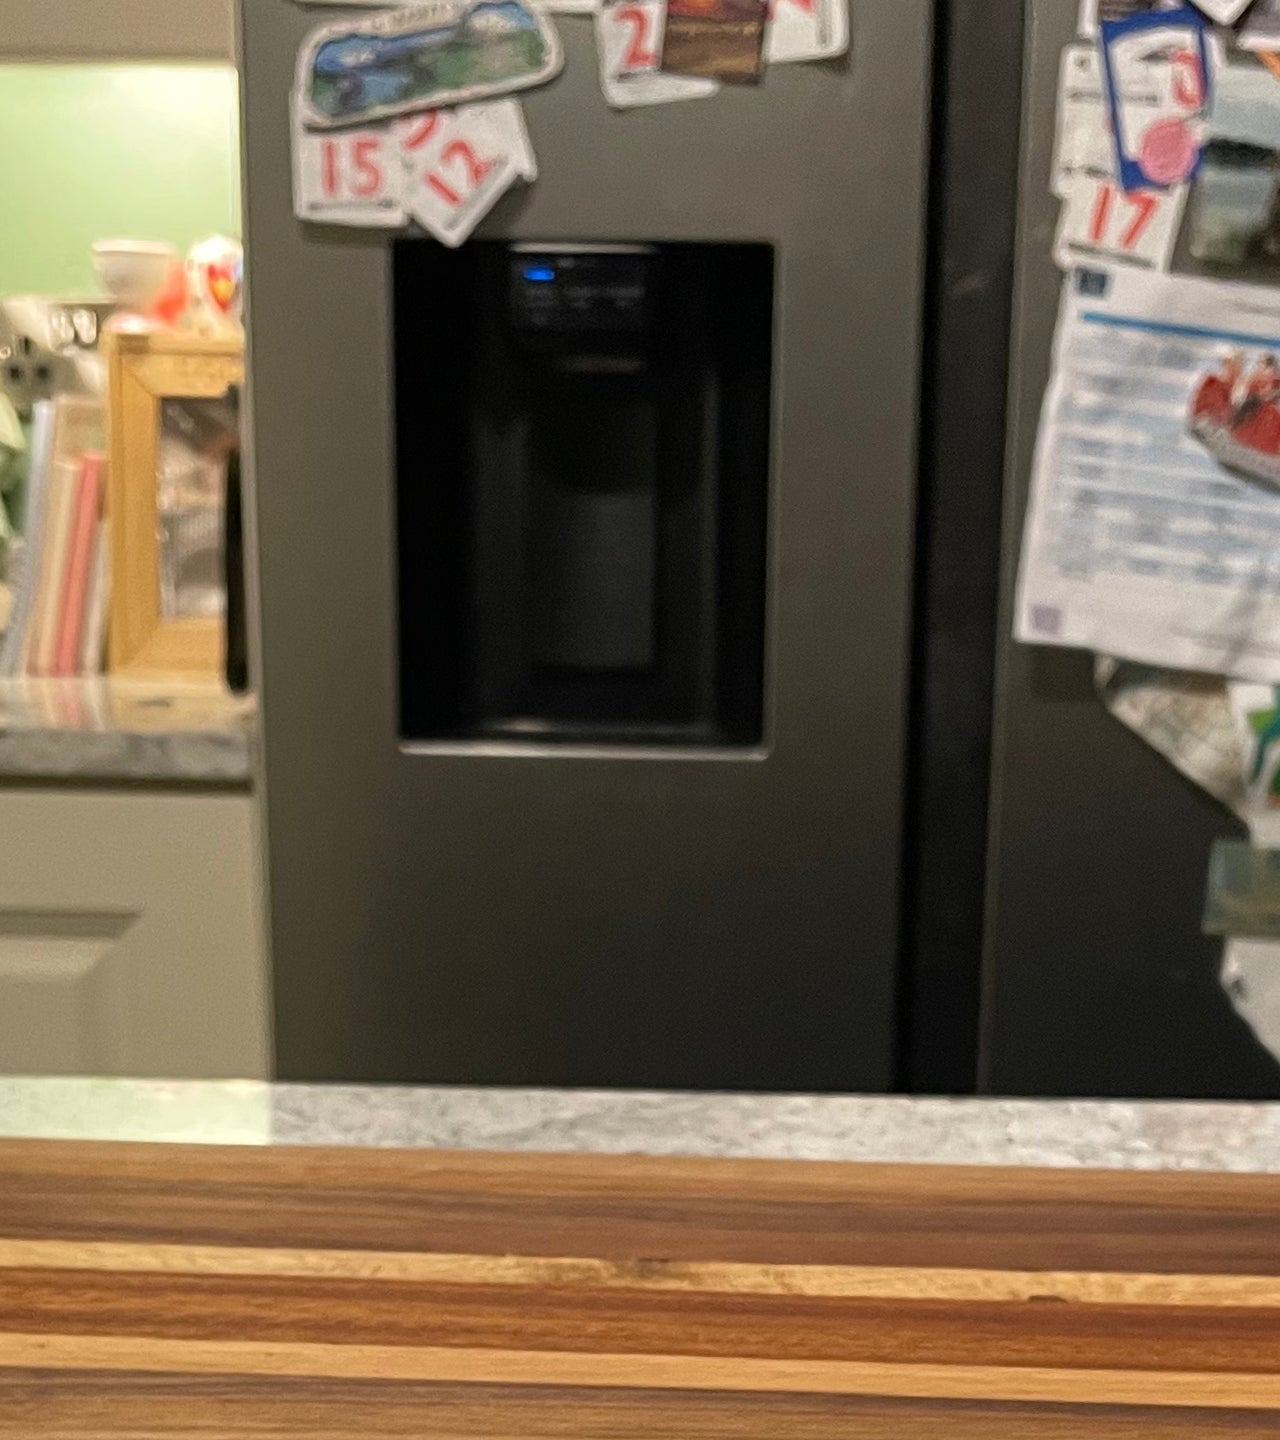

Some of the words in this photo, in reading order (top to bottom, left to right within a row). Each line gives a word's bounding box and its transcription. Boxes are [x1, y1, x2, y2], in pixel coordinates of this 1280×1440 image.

[322, 133, 384, 195] 15
[425, 139, 492, 206] 12
[1090, 185, 1158, 249] 17
